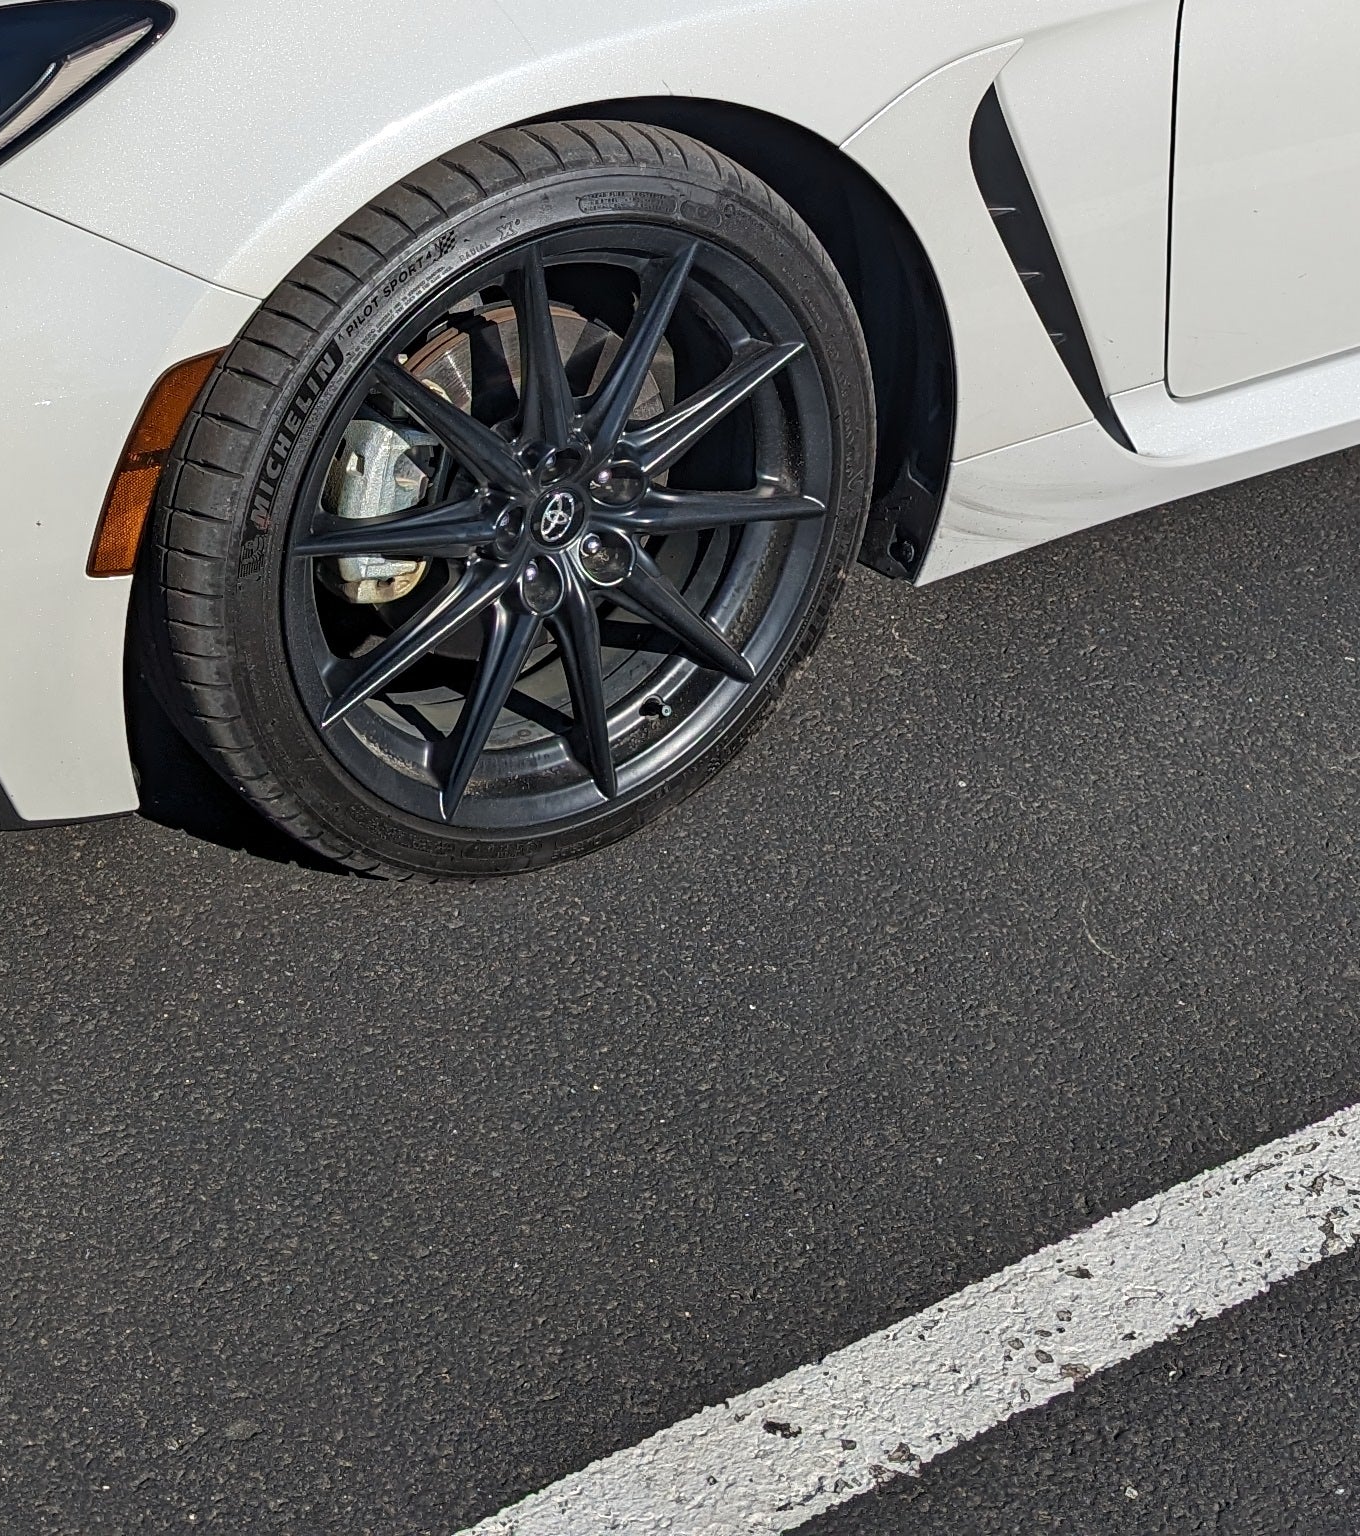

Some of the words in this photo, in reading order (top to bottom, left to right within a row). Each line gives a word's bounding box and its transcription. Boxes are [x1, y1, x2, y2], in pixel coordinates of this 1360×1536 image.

[458, 240, 492, 263] RADIAL
[249, 349, 339, 531] MICHELIN
[346, 298, 380, 338] PILOT
[383, 260, 425, 299] SPORT
